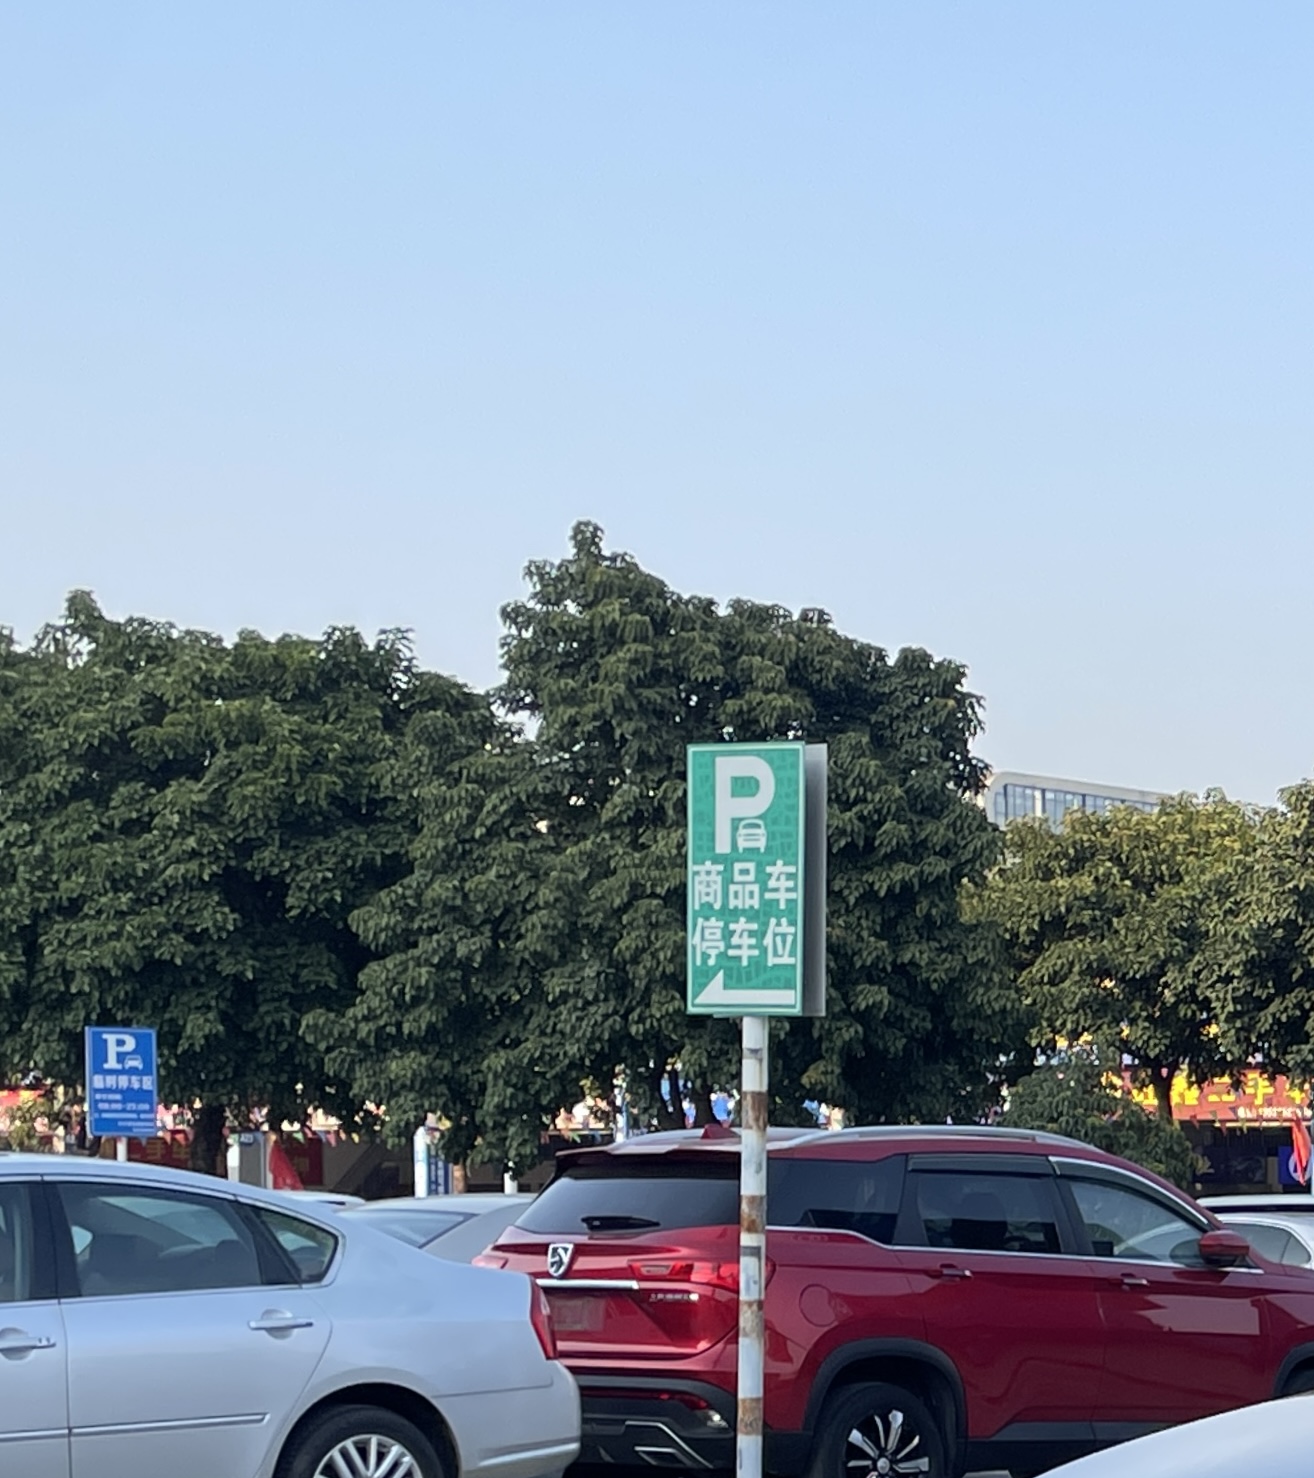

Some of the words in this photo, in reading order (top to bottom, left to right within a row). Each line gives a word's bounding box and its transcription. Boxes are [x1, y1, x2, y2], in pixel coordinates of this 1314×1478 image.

[714, 756, 775, 854] P
[692, 859, 798, 911] 商品车
[691, 917, 797, 967] 停车位
[101, 1033, 136, 1070] P
